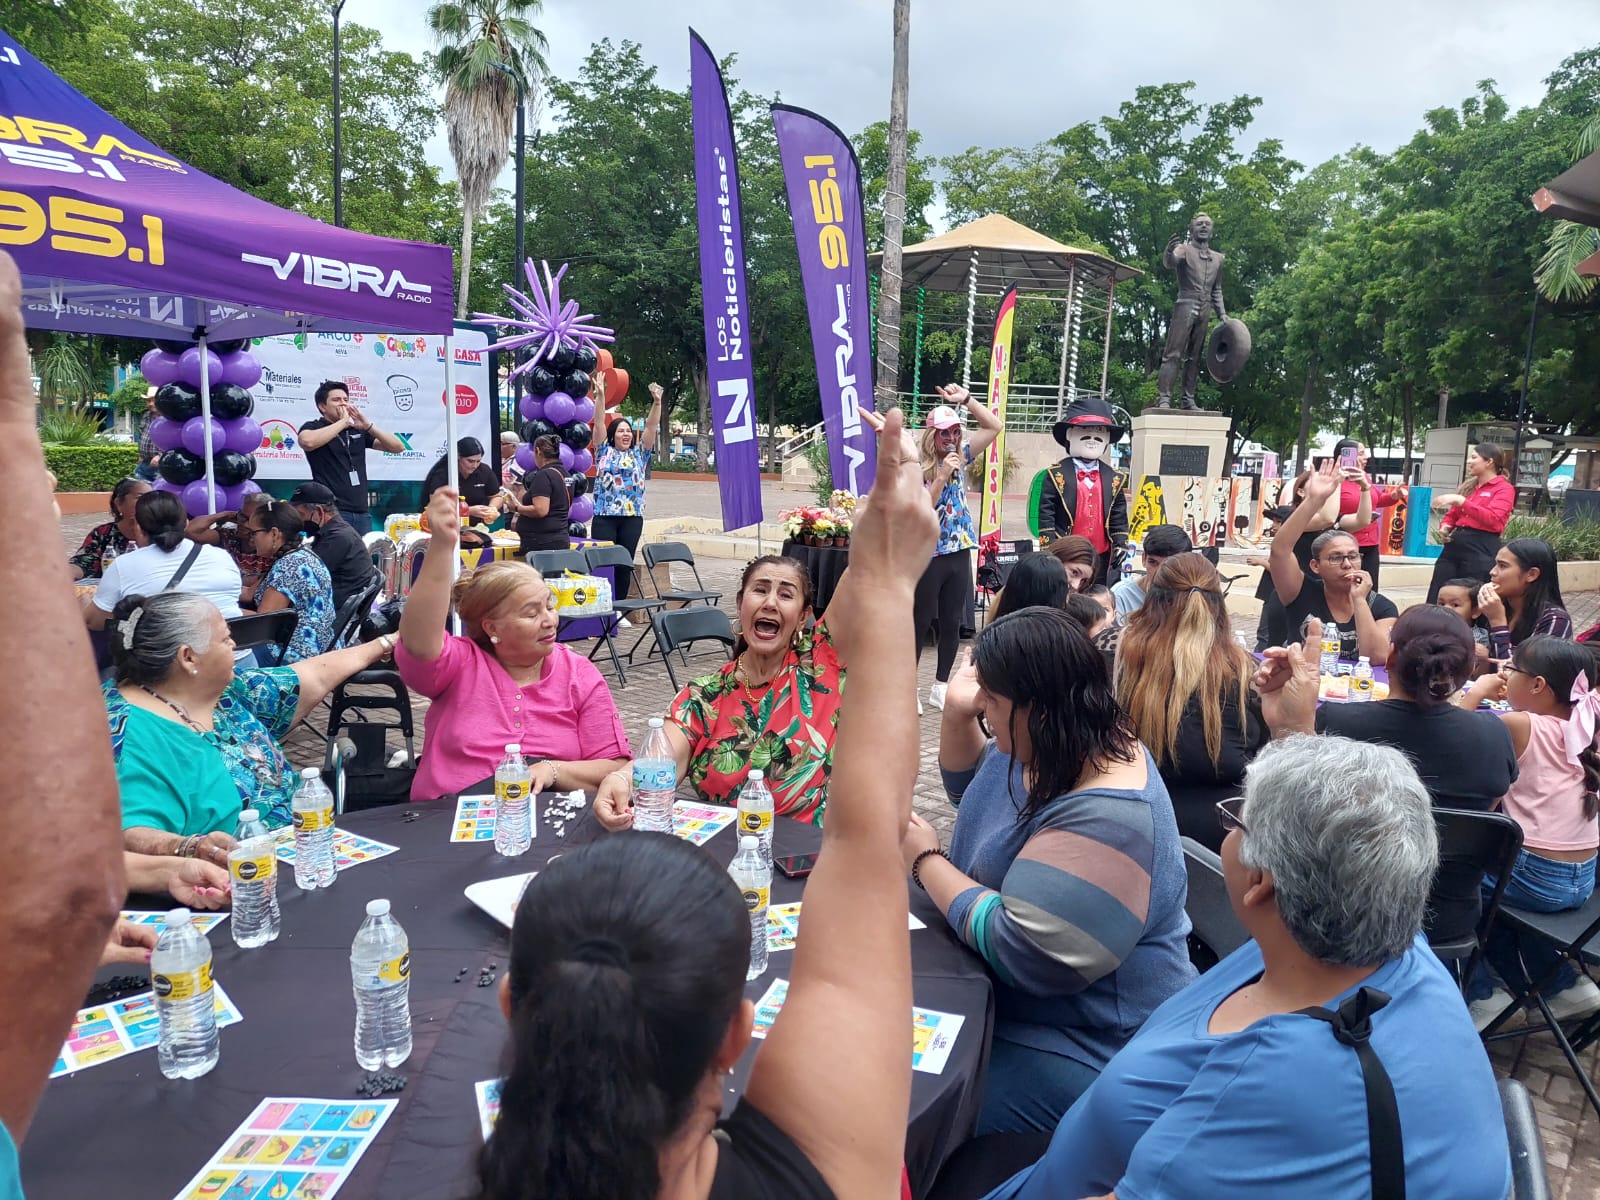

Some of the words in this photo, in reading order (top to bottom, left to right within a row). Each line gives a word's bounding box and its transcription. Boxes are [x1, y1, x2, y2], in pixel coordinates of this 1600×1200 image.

[0, 142, 127, 182] 5.1
[804, 155, 849, 269] 95.1
[241, 251, 432, 298] VIBRA
[397, 292, 432, 304] RADIO
[717, 155, 743, 361] Noticieristas
[265, 371, 302, 384] Materiales
